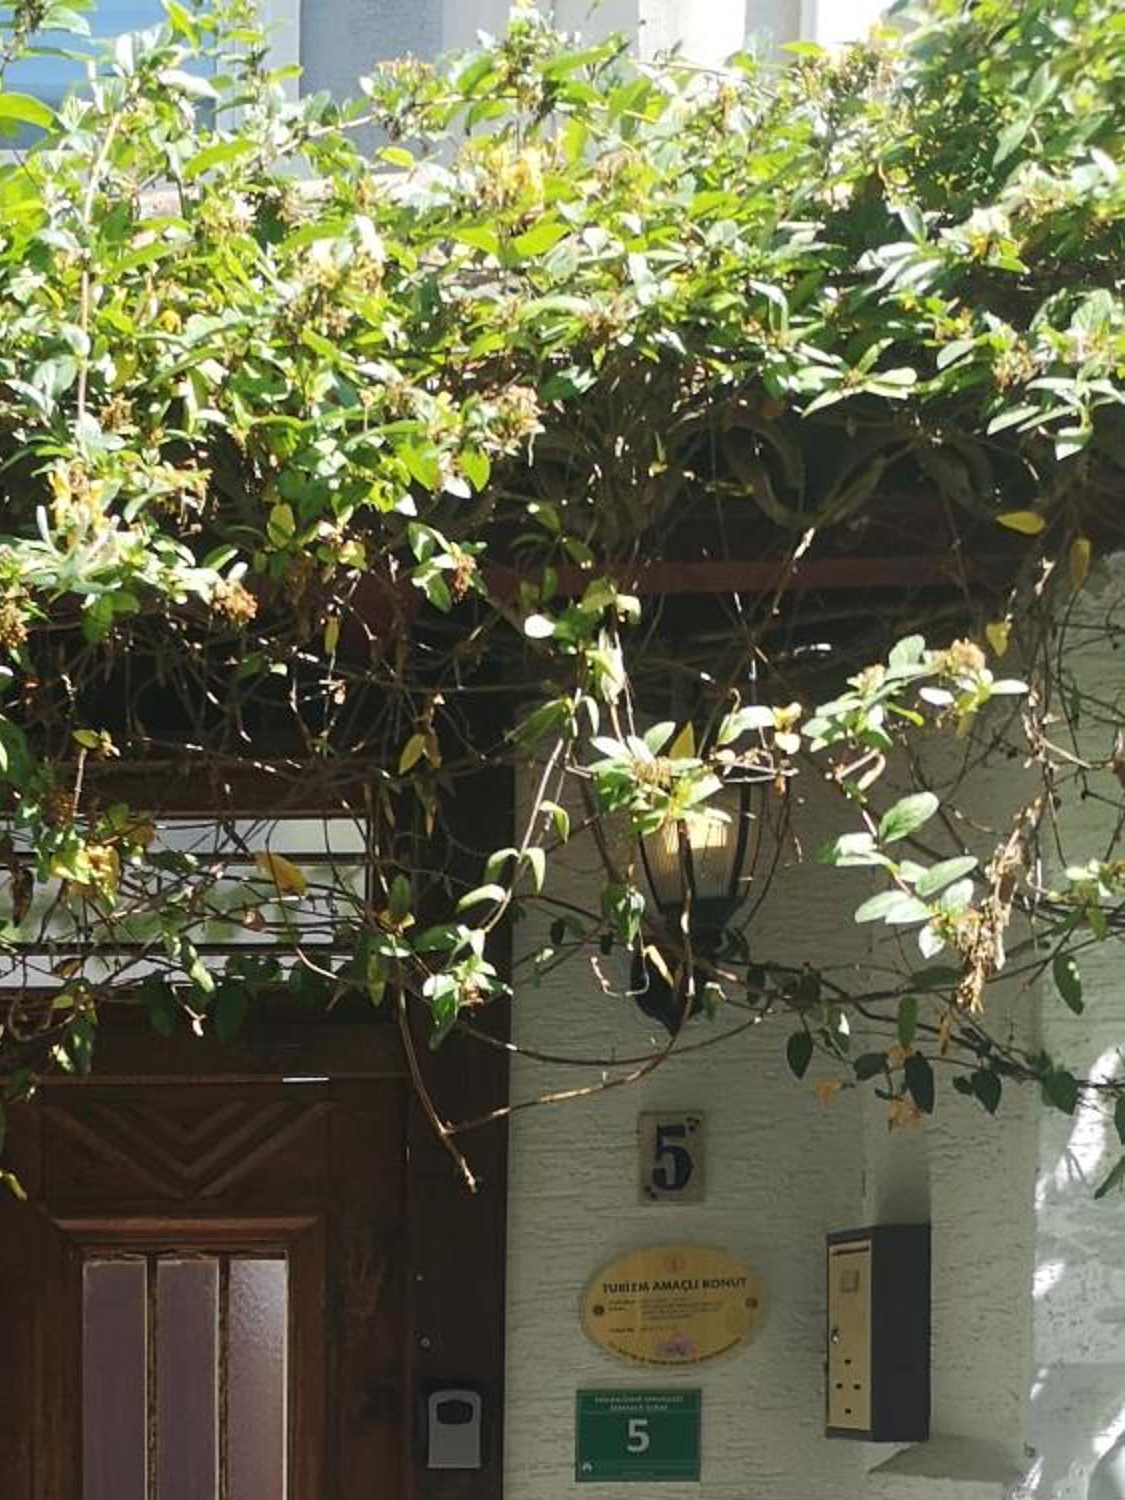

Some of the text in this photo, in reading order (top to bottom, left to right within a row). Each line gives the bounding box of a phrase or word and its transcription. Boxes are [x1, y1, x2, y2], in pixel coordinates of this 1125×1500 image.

[652, 1123, 695, 1192] 5
[702, 1276, 748, 1290] KONUT
[626, 1418, 650, 1453] 5
